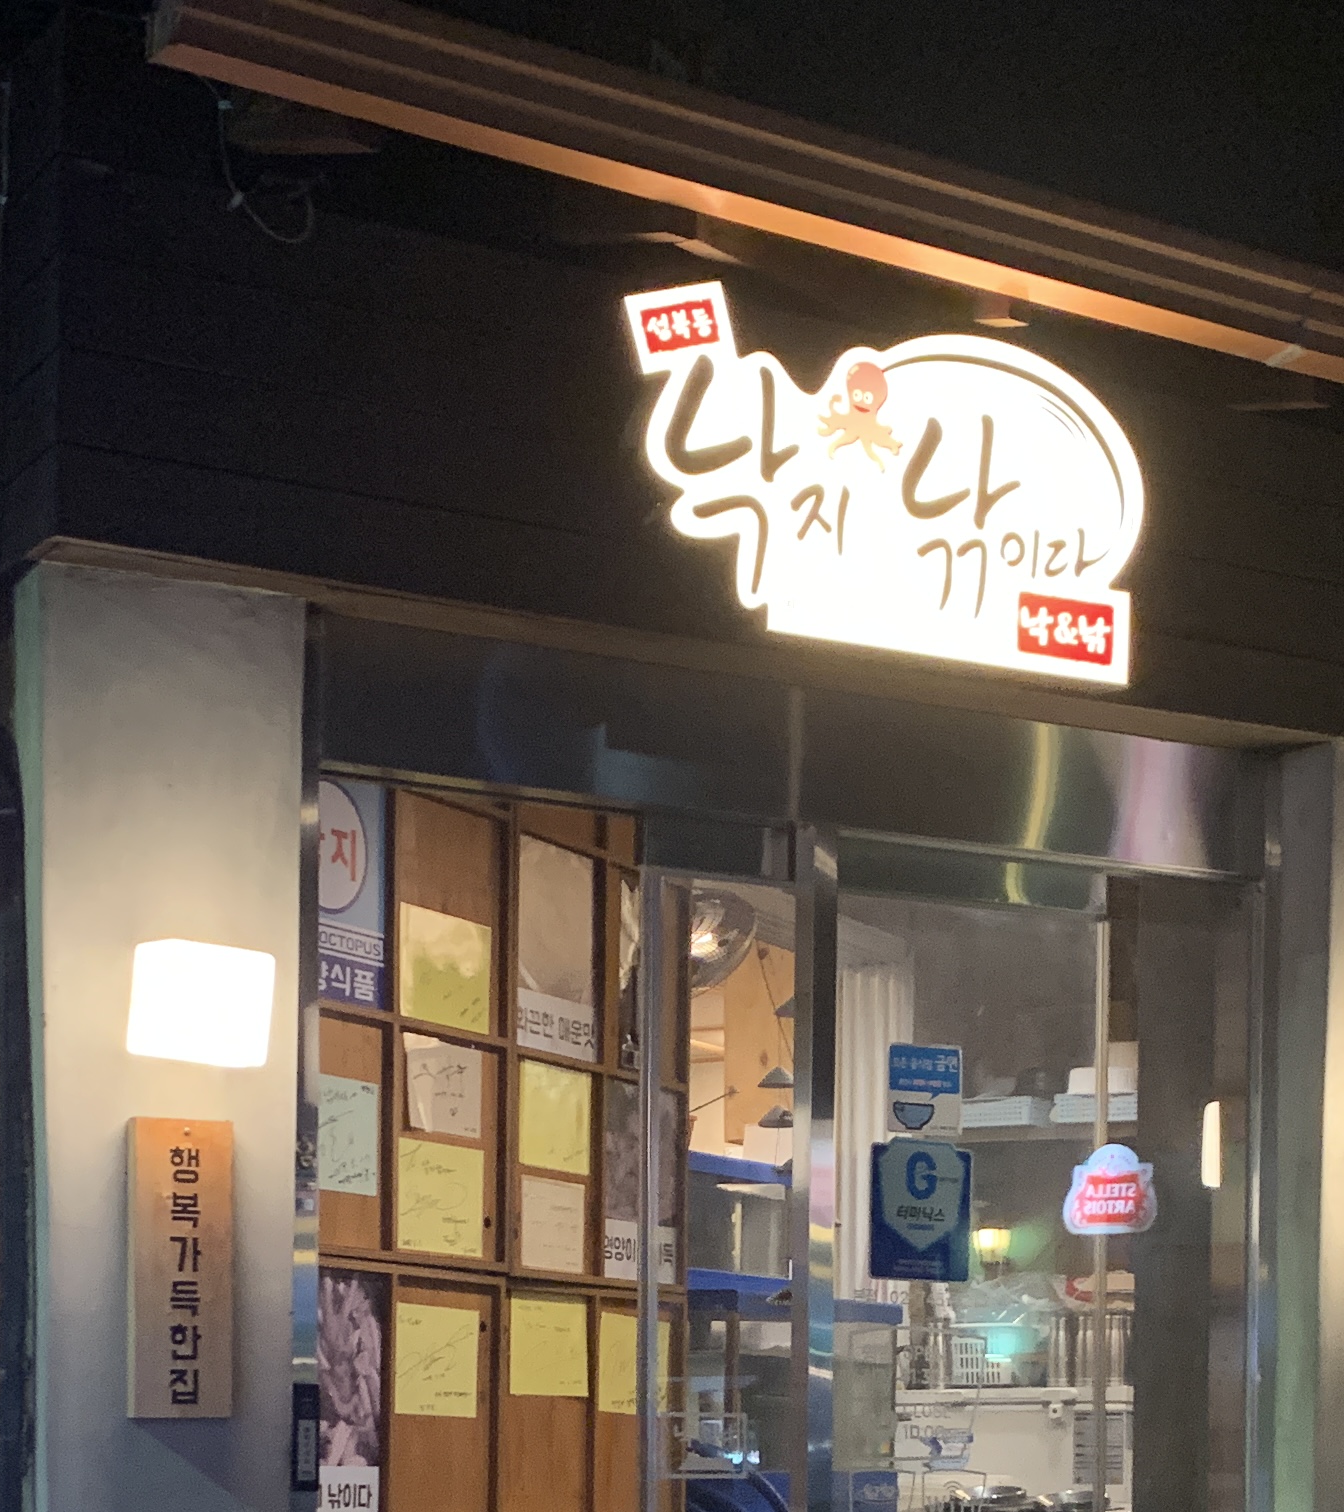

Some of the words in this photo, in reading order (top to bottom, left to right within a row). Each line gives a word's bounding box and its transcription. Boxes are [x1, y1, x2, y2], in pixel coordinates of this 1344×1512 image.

[646, 309, 713, 342] 성북동
[664, 354, 850, 594] 낙지
[901, 414, 1109, 619] 낚이다
[897, 1205, 946, 1222] 터미닉스
[328, 1483, 373, 1509] 낚이다
